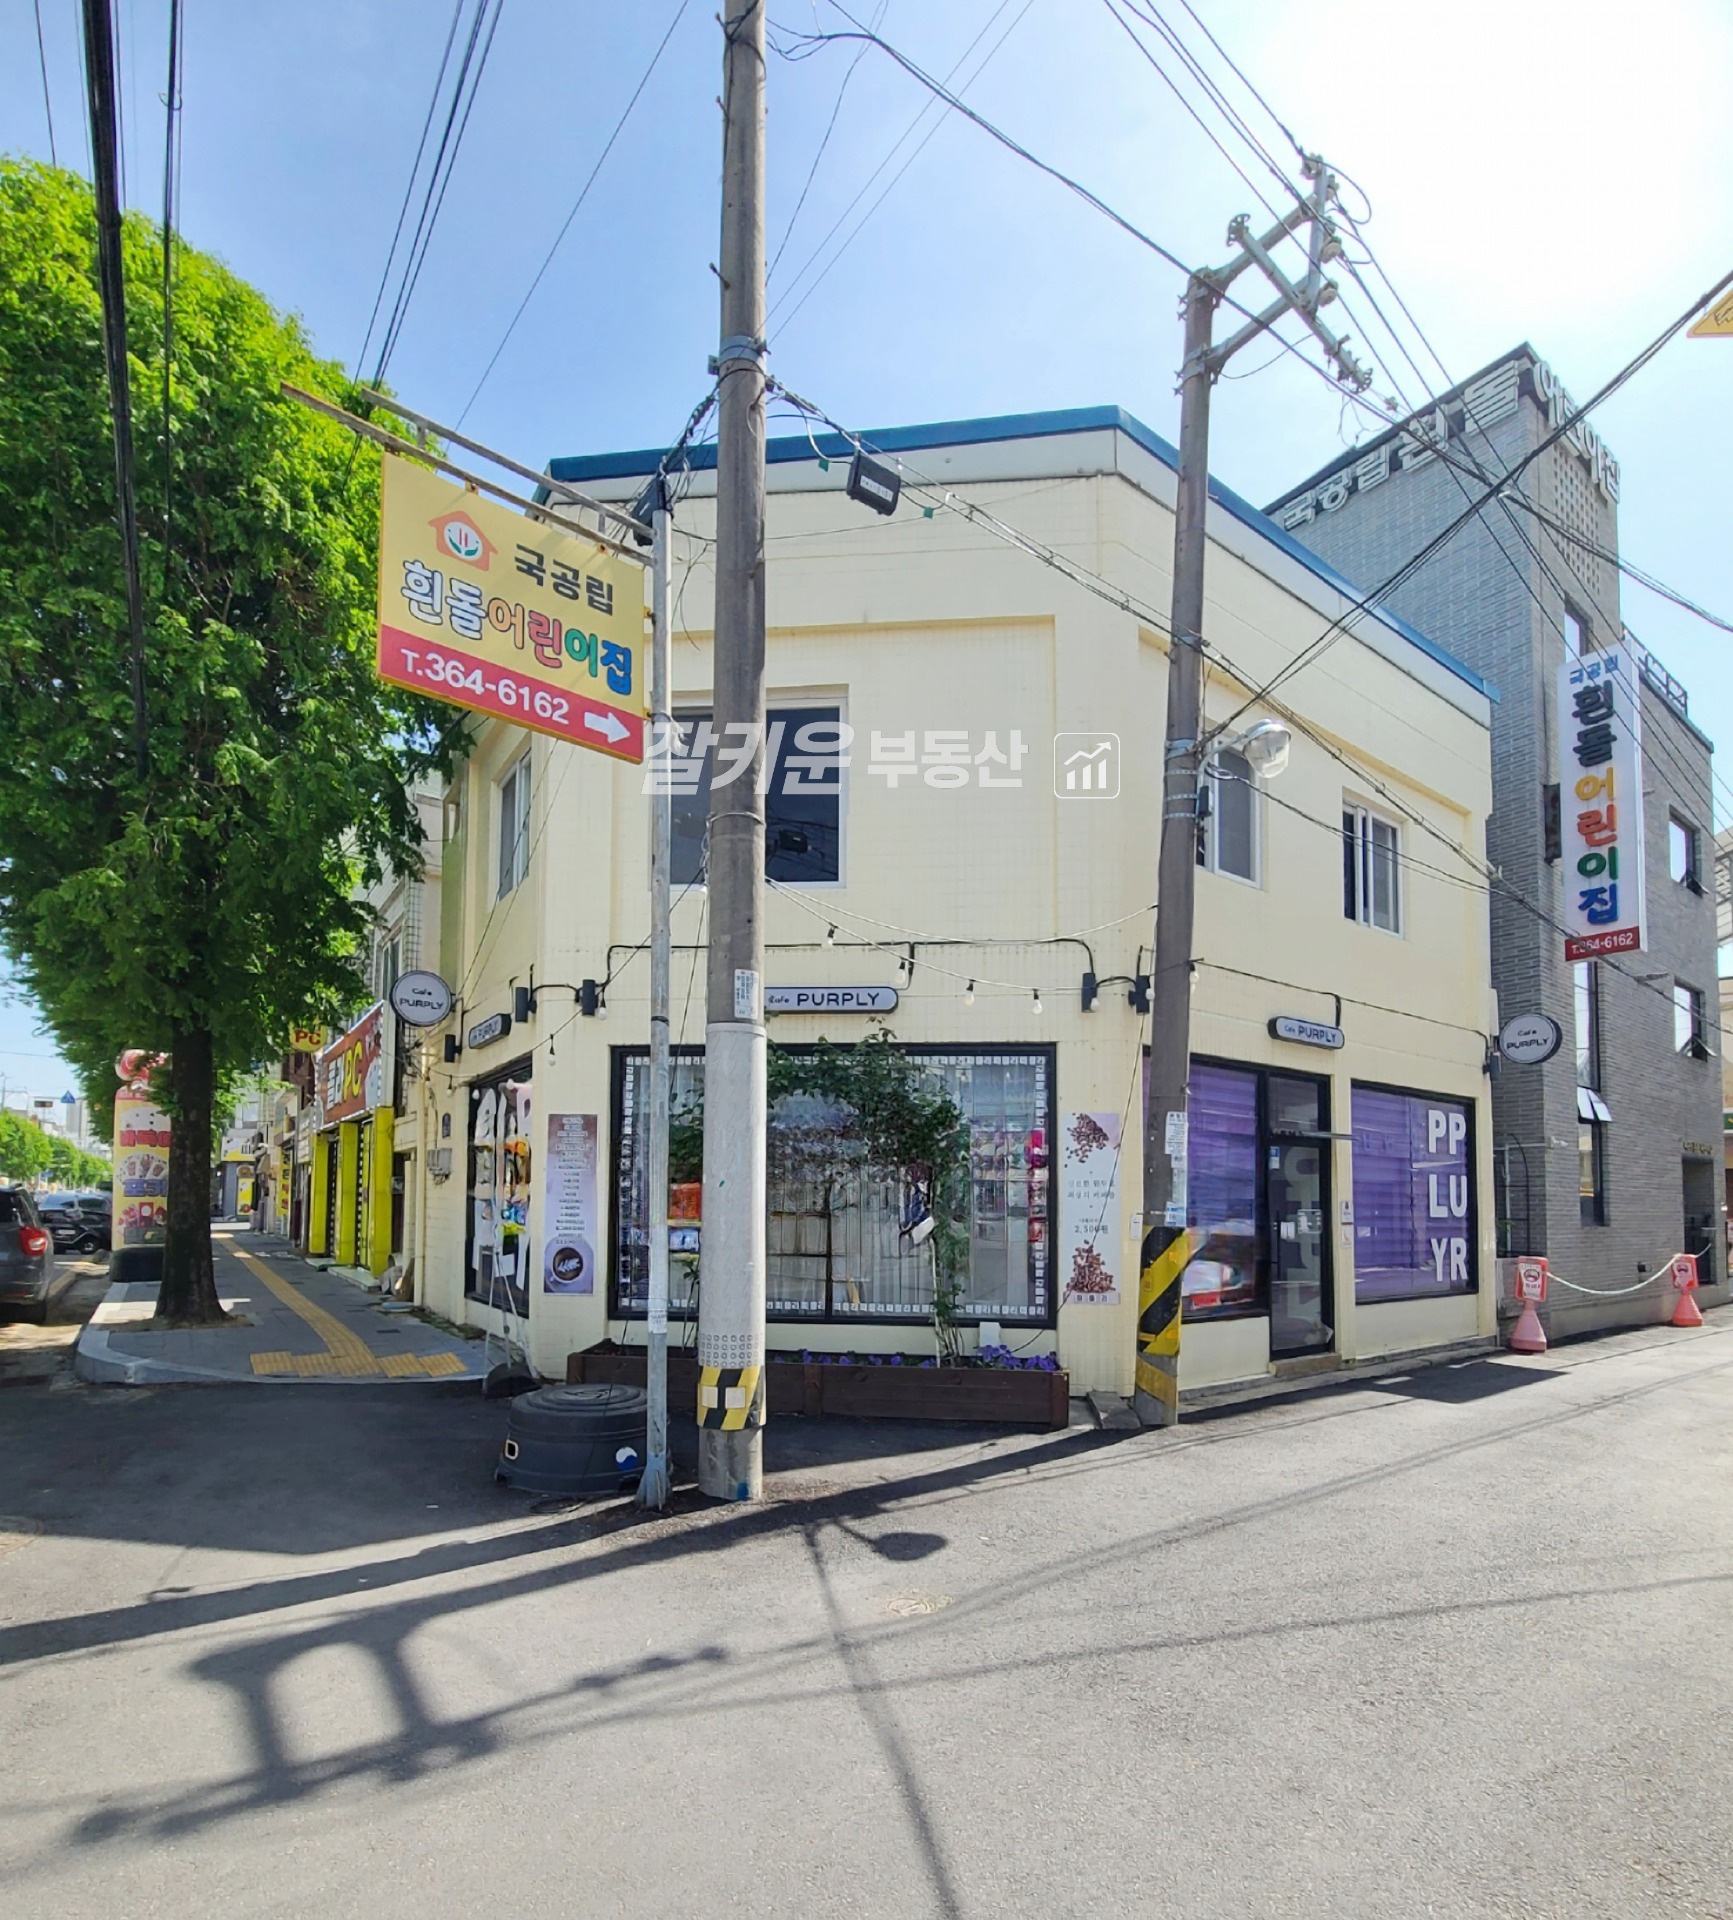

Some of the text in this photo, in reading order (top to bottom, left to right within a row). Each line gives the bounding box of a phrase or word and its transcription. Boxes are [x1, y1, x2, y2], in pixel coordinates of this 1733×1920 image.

[1283, 443, 1391, 531] 국공립
[513, 542, 614, 617] 국공립
[400, 559, 632, 696] 흰돌어린이집
[1569, 653, 1620, 684] 국공립
[400, 648, 569, 726] T.364-6162
[1572, 679, 1619, 926] 흰돌어린이집
[399, 998, 444, 1010] PURPLY
[796, 992, 880, 1007] PURPLY
[294, 1028, 321, 1045] PC
[1298, 1025, 1337, 1043] PURPLY
[1506, 1037, 1550, 1050] PURPLY
